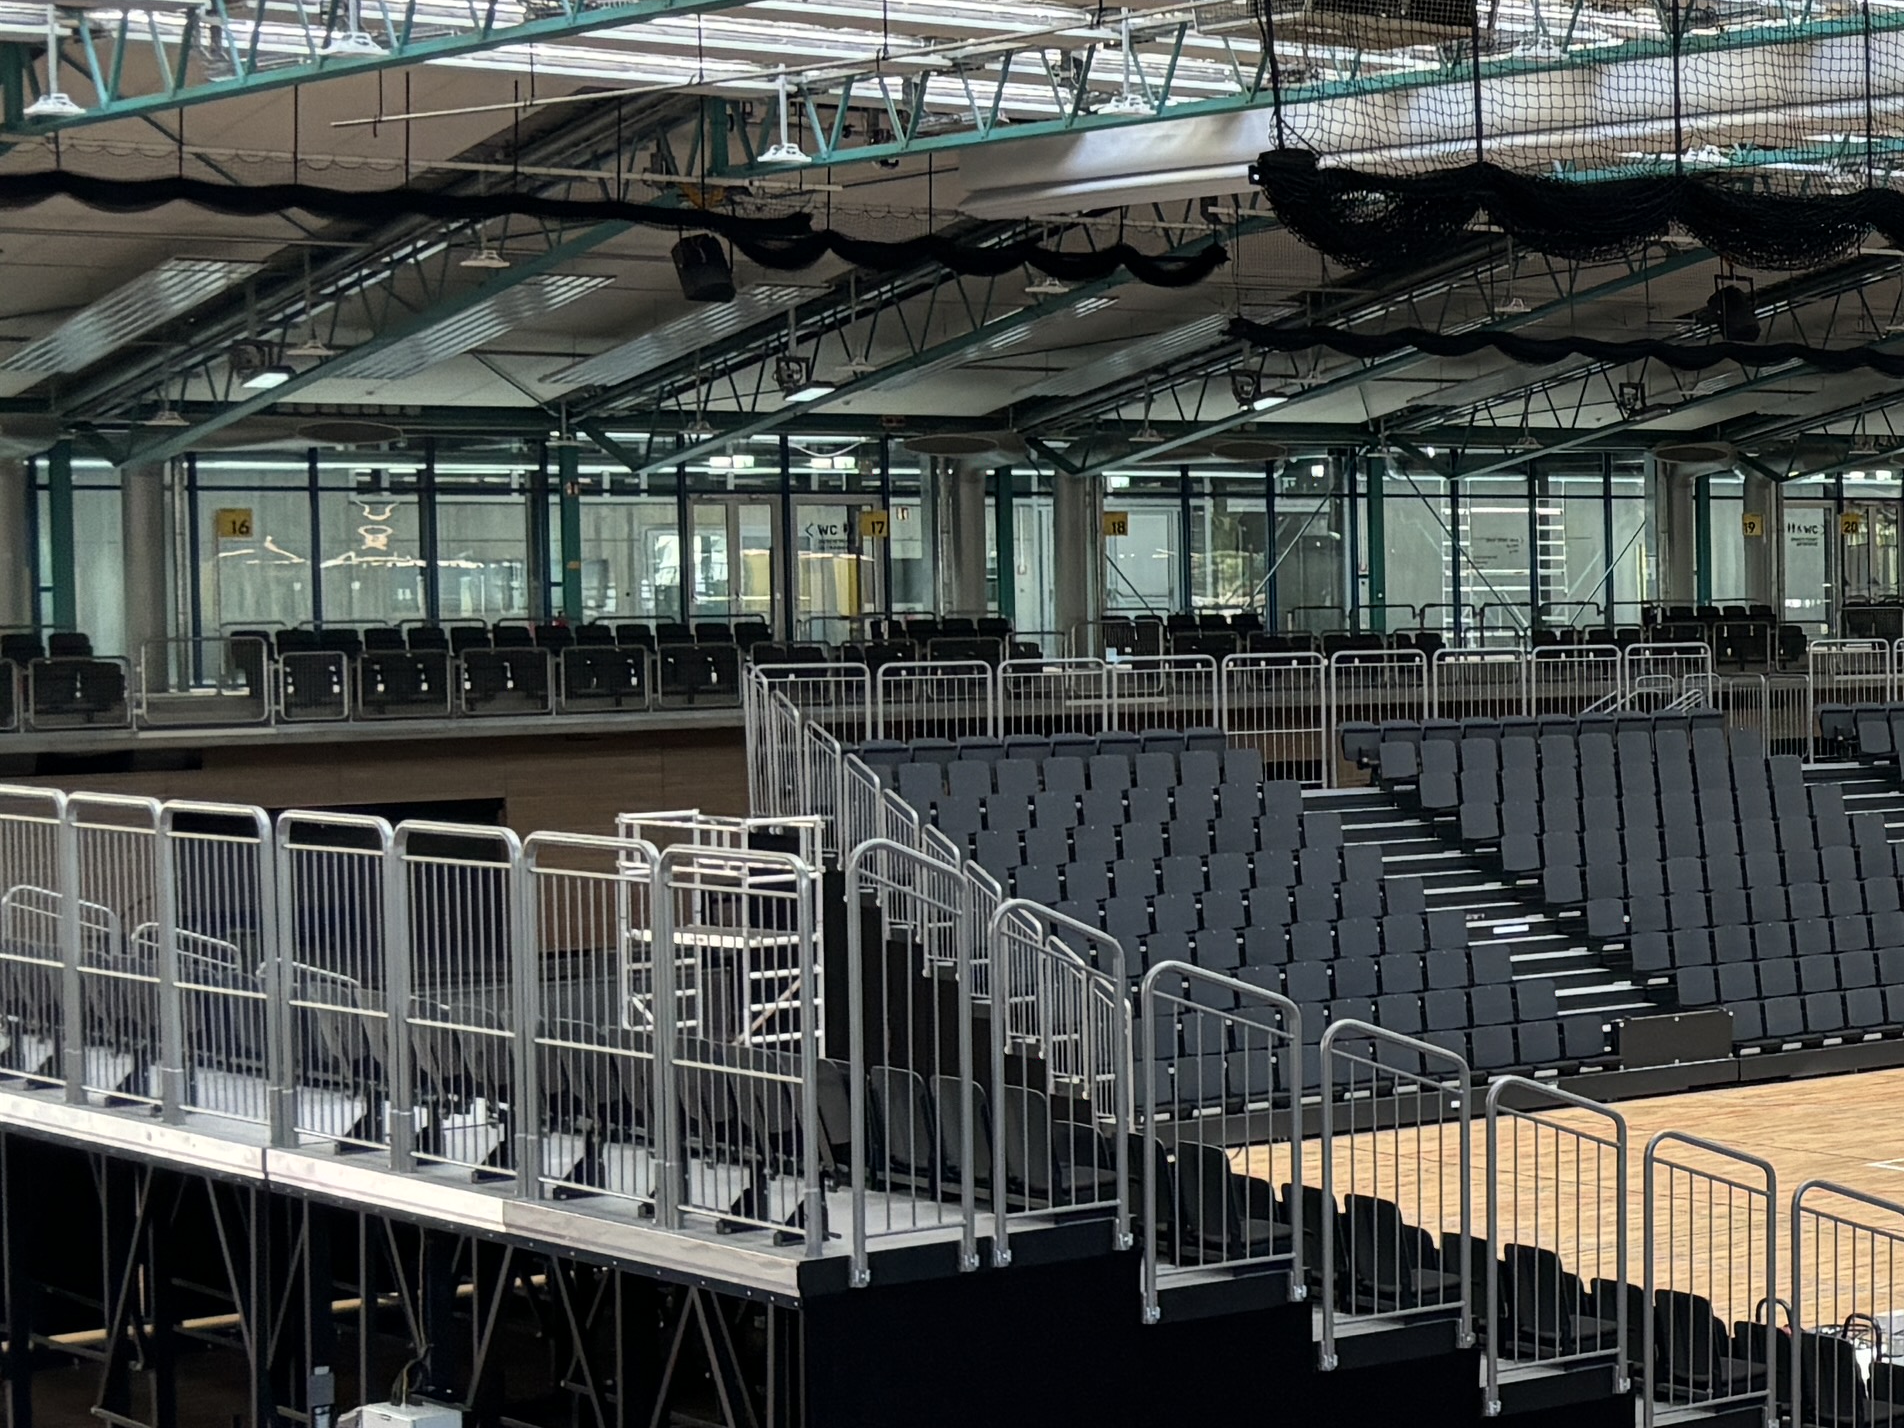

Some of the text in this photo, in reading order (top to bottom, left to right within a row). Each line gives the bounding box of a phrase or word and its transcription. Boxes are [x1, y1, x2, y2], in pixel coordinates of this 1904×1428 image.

[232, 519, 250, 535] 16
[818, 523, 838, 536] WC
[872, 521, 884, 534] 17
[1112, 521, 1126, 534] 18
[1744, 522, 1756, 534] 19
[1804, 524, 1818, 534] WC
[1844, 521, 1858, 533] 20
